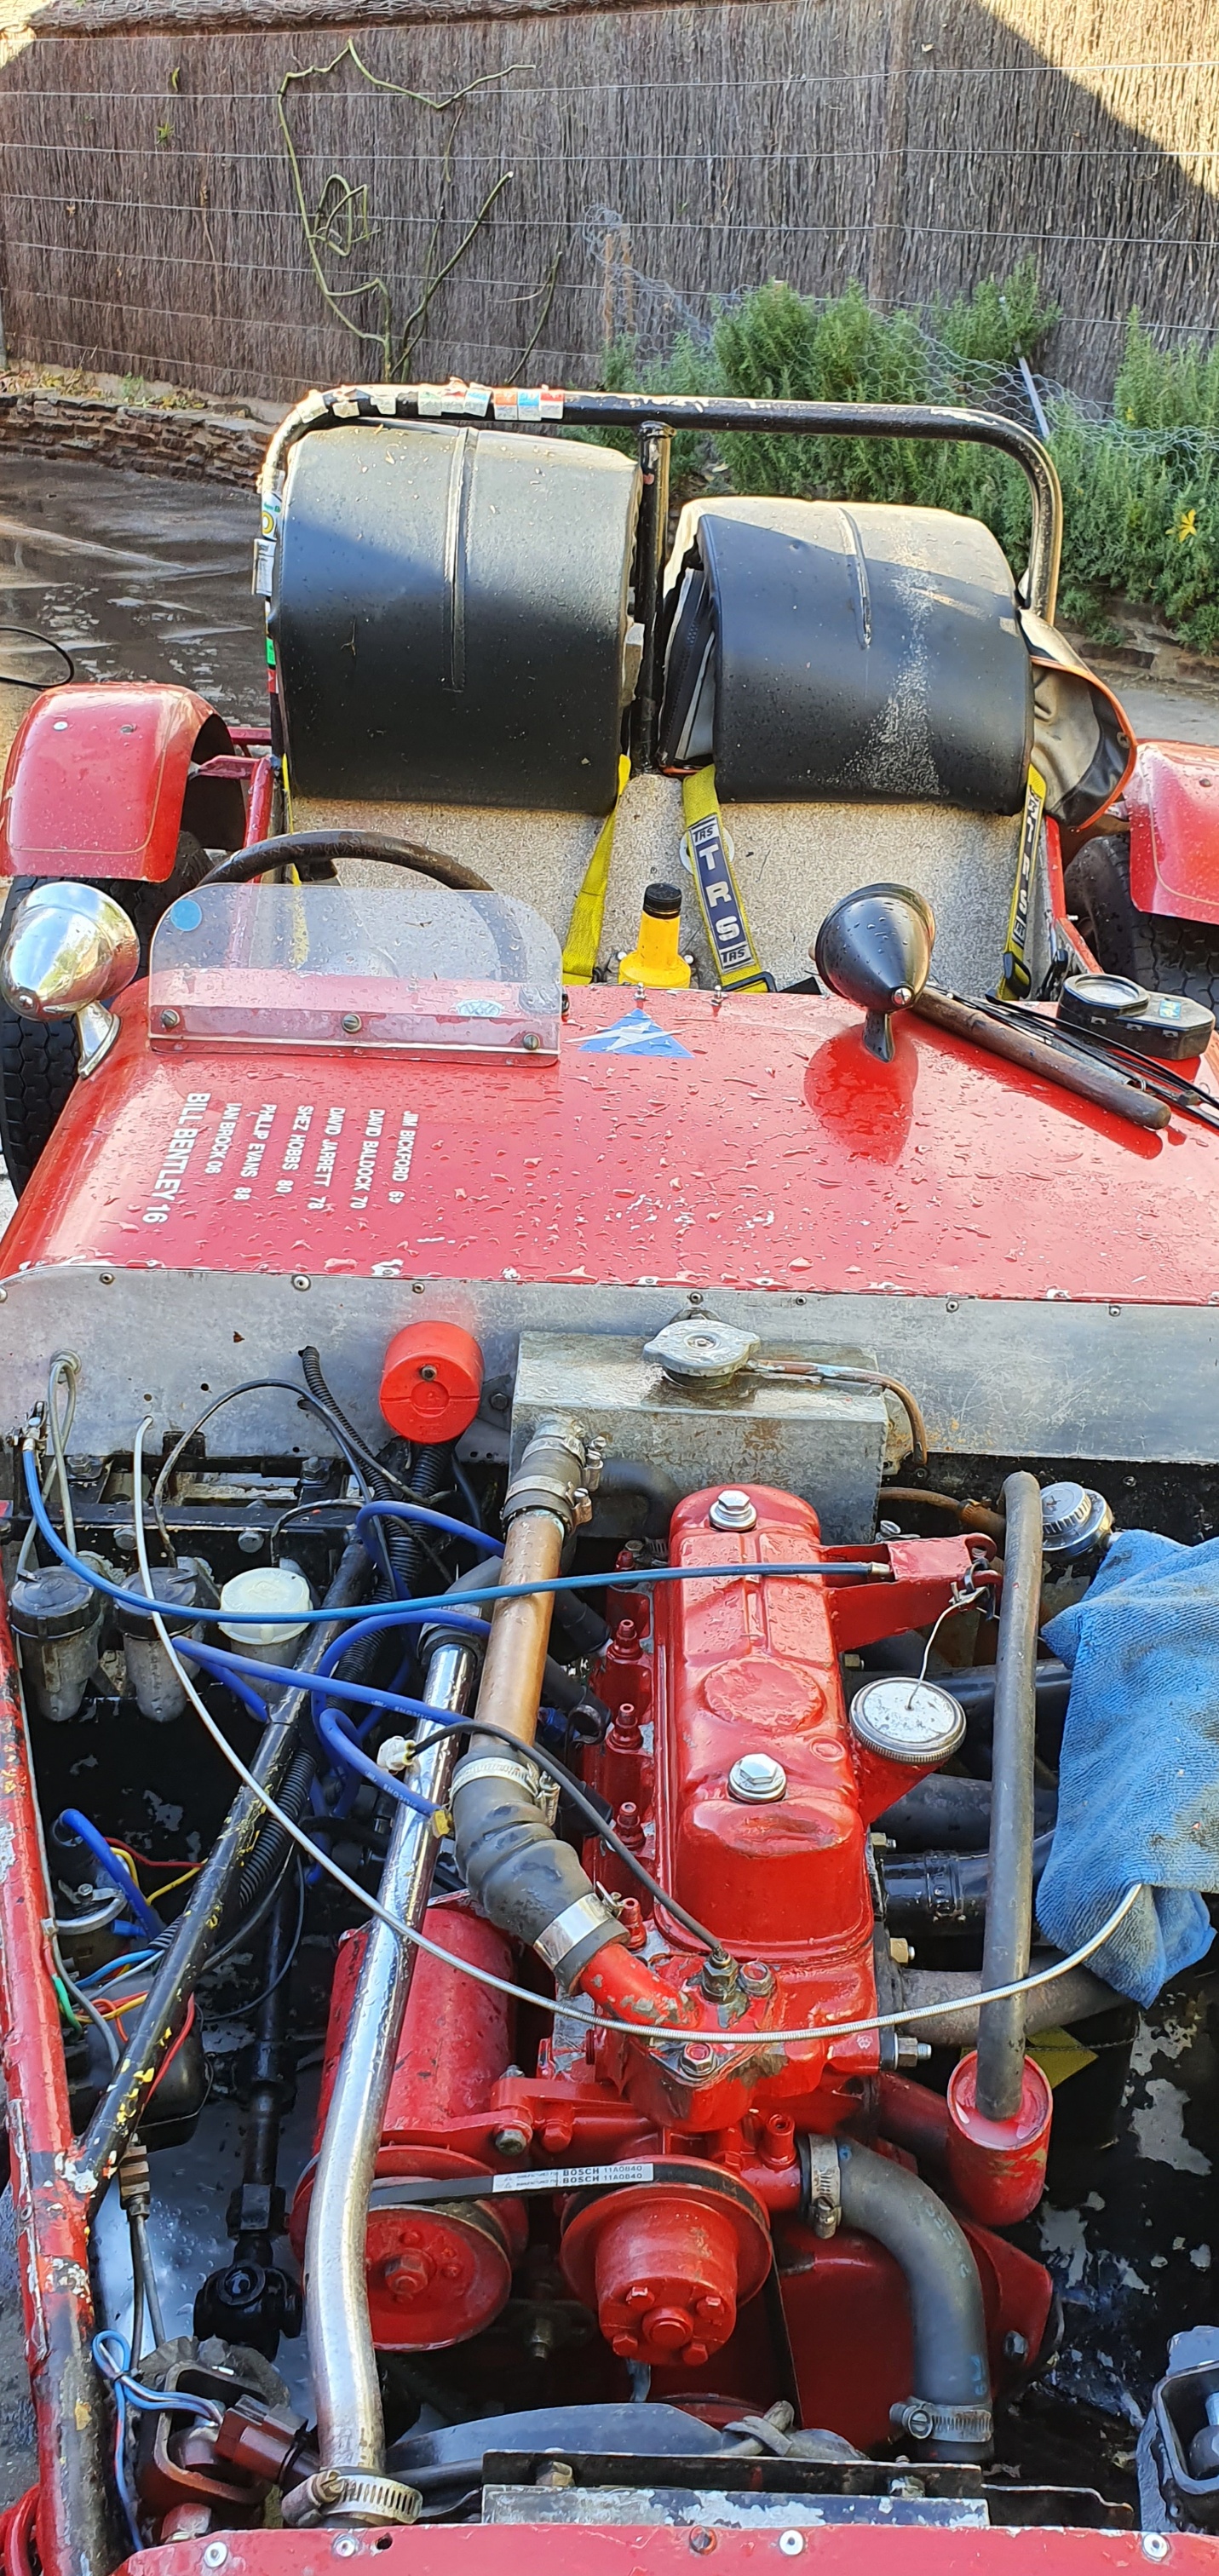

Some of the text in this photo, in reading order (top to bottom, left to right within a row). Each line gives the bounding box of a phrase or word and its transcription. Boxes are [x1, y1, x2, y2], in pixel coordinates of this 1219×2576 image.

[693, 824, 714, 842] TRS
[721, 944, 746, 963] TRS
[204, 1102, 243, 1174] IAN BROCK 06
[275, 1105, 315, 1193] SHEZ HOBBS 80
[401, 1110, 420, 1127] JIM
[141, 1092, 211, 1223] BILL BENTLEY 16
[233, 1103, 278, 1200] PHILLIP EVANS 88
[307, 1107, 346, 1210] DAVID JARRETT 78
[349, 1108, 386, 1209] DAVID BALDOCK 70
[391, 1130, 417, 1182] BICKFORD
[562, 2167, 600, 2176] BOSCH
[562, 2175, 600, 2184] BOSCH
